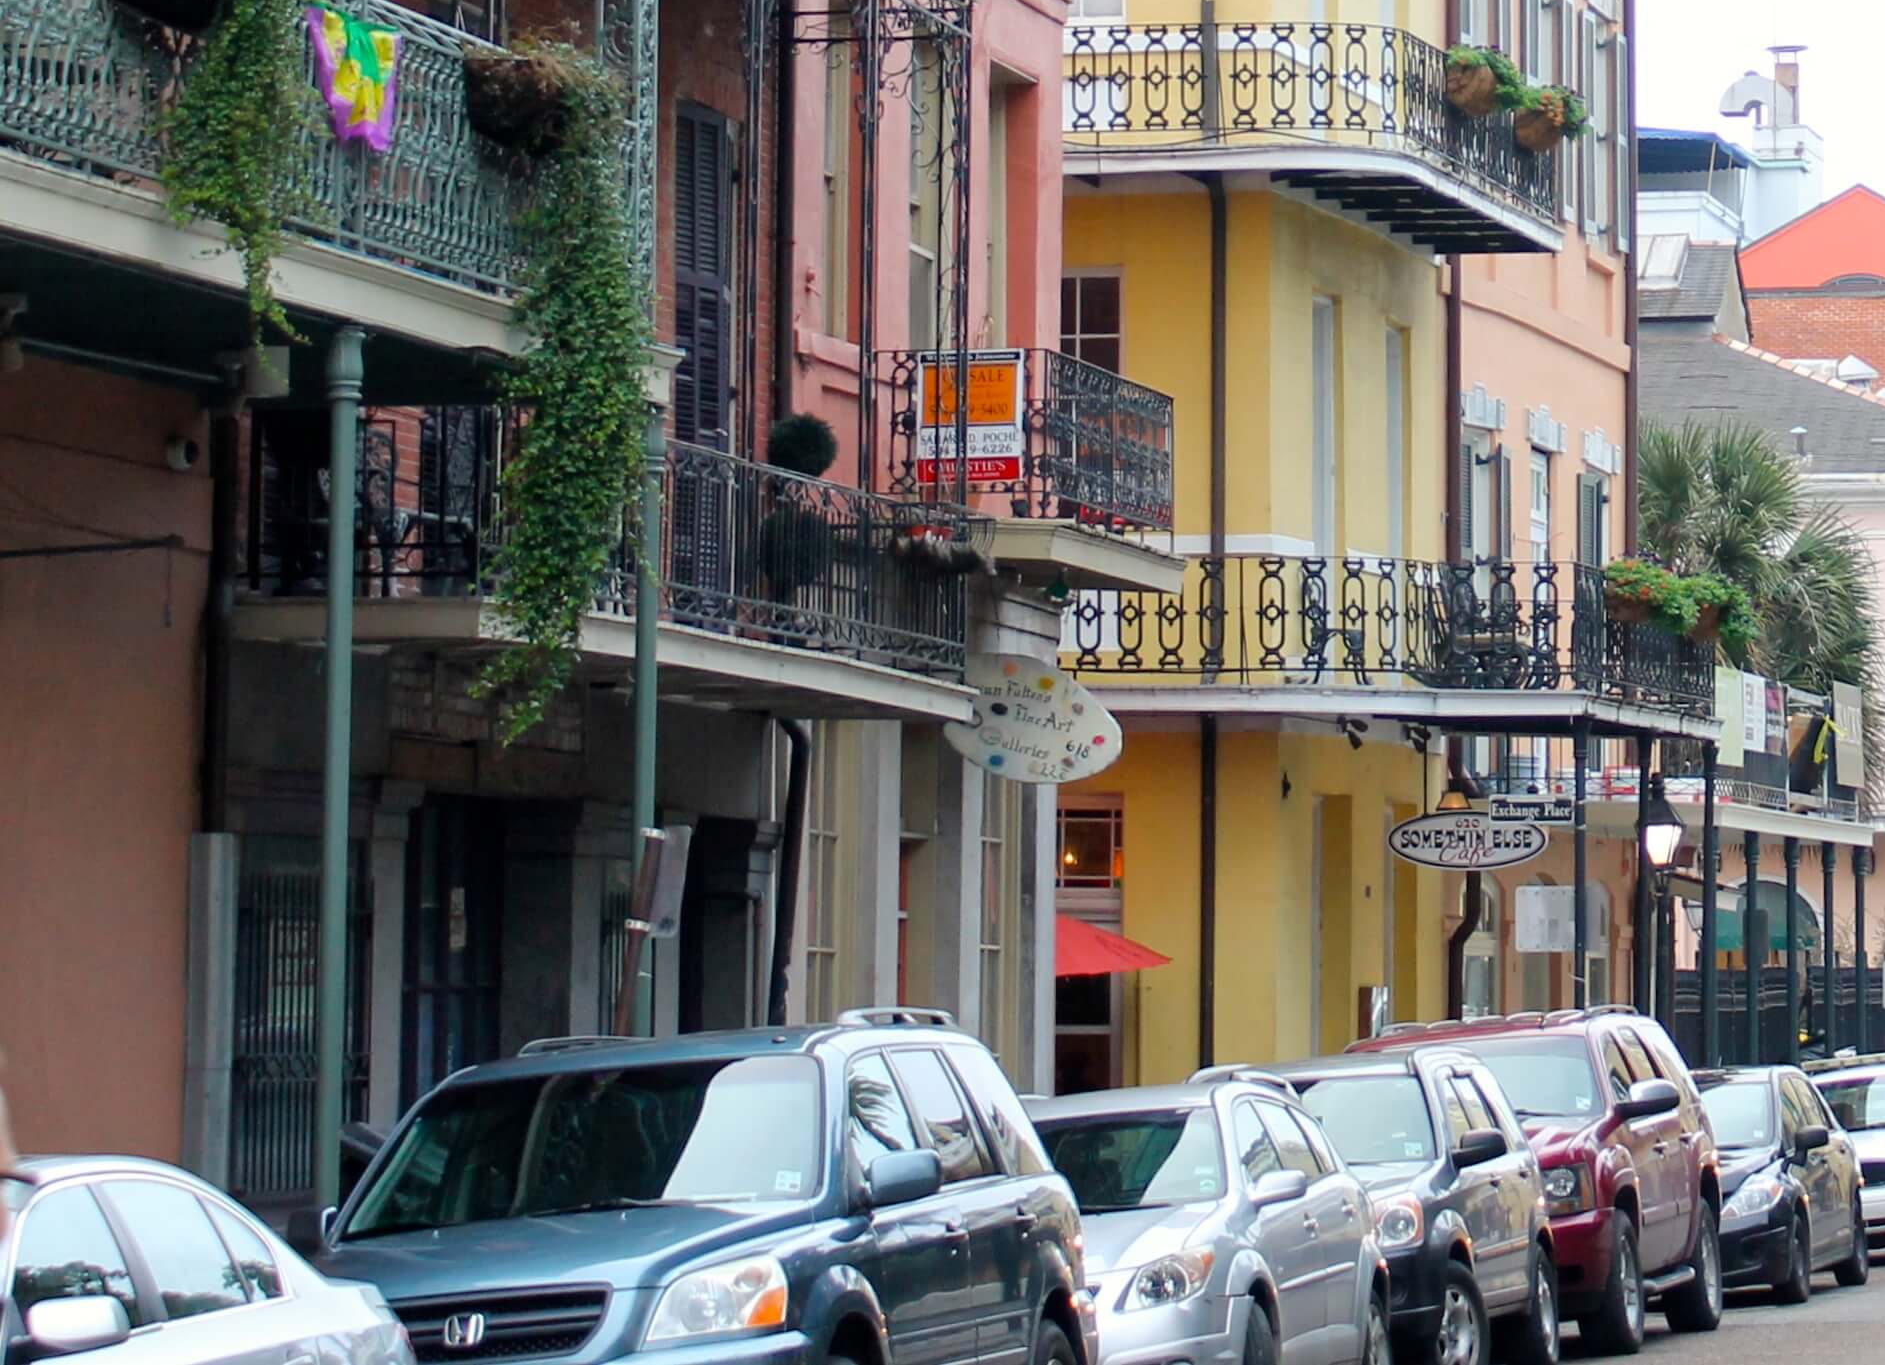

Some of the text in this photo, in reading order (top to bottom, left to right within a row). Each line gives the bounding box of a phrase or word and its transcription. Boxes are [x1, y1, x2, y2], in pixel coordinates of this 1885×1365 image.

[968, 369, 1006, 384] SALE
[1042, 711, 1075, 733] Art
[979, 725, 1050, 760] Galleries
[1065, 740, 1090, 759] 618
[1491, 803, 1571, 821] Exchange Place
[1492, 829, 1533, 849] ELSE
